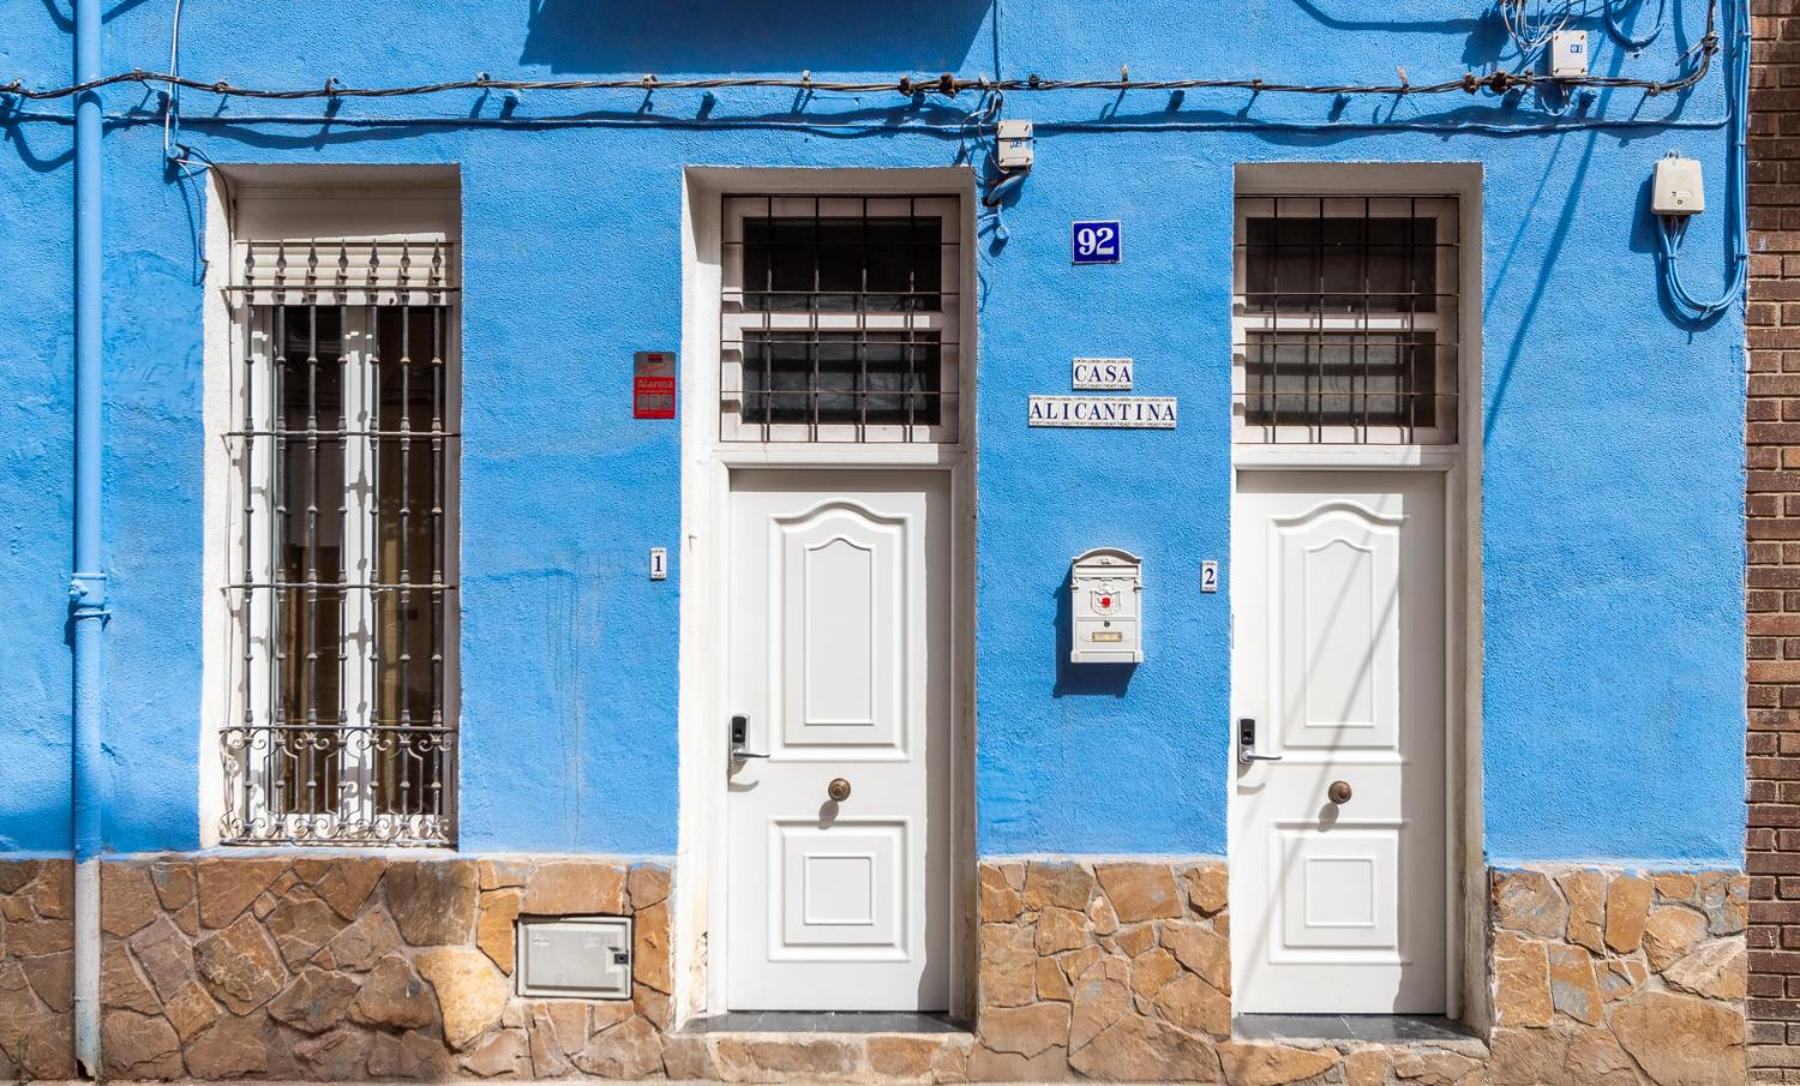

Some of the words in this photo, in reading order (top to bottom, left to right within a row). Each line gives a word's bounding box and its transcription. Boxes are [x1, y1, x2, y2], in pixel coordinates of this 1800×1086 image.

[1078, 227, 1114, 255] 92
[1074, 364, 1131, 383] CASA
[1030, 402, 1175, 421] ALICANTINA
[655, 555, 662, 571] 1
[1205, 568, 1214, 584] 2
